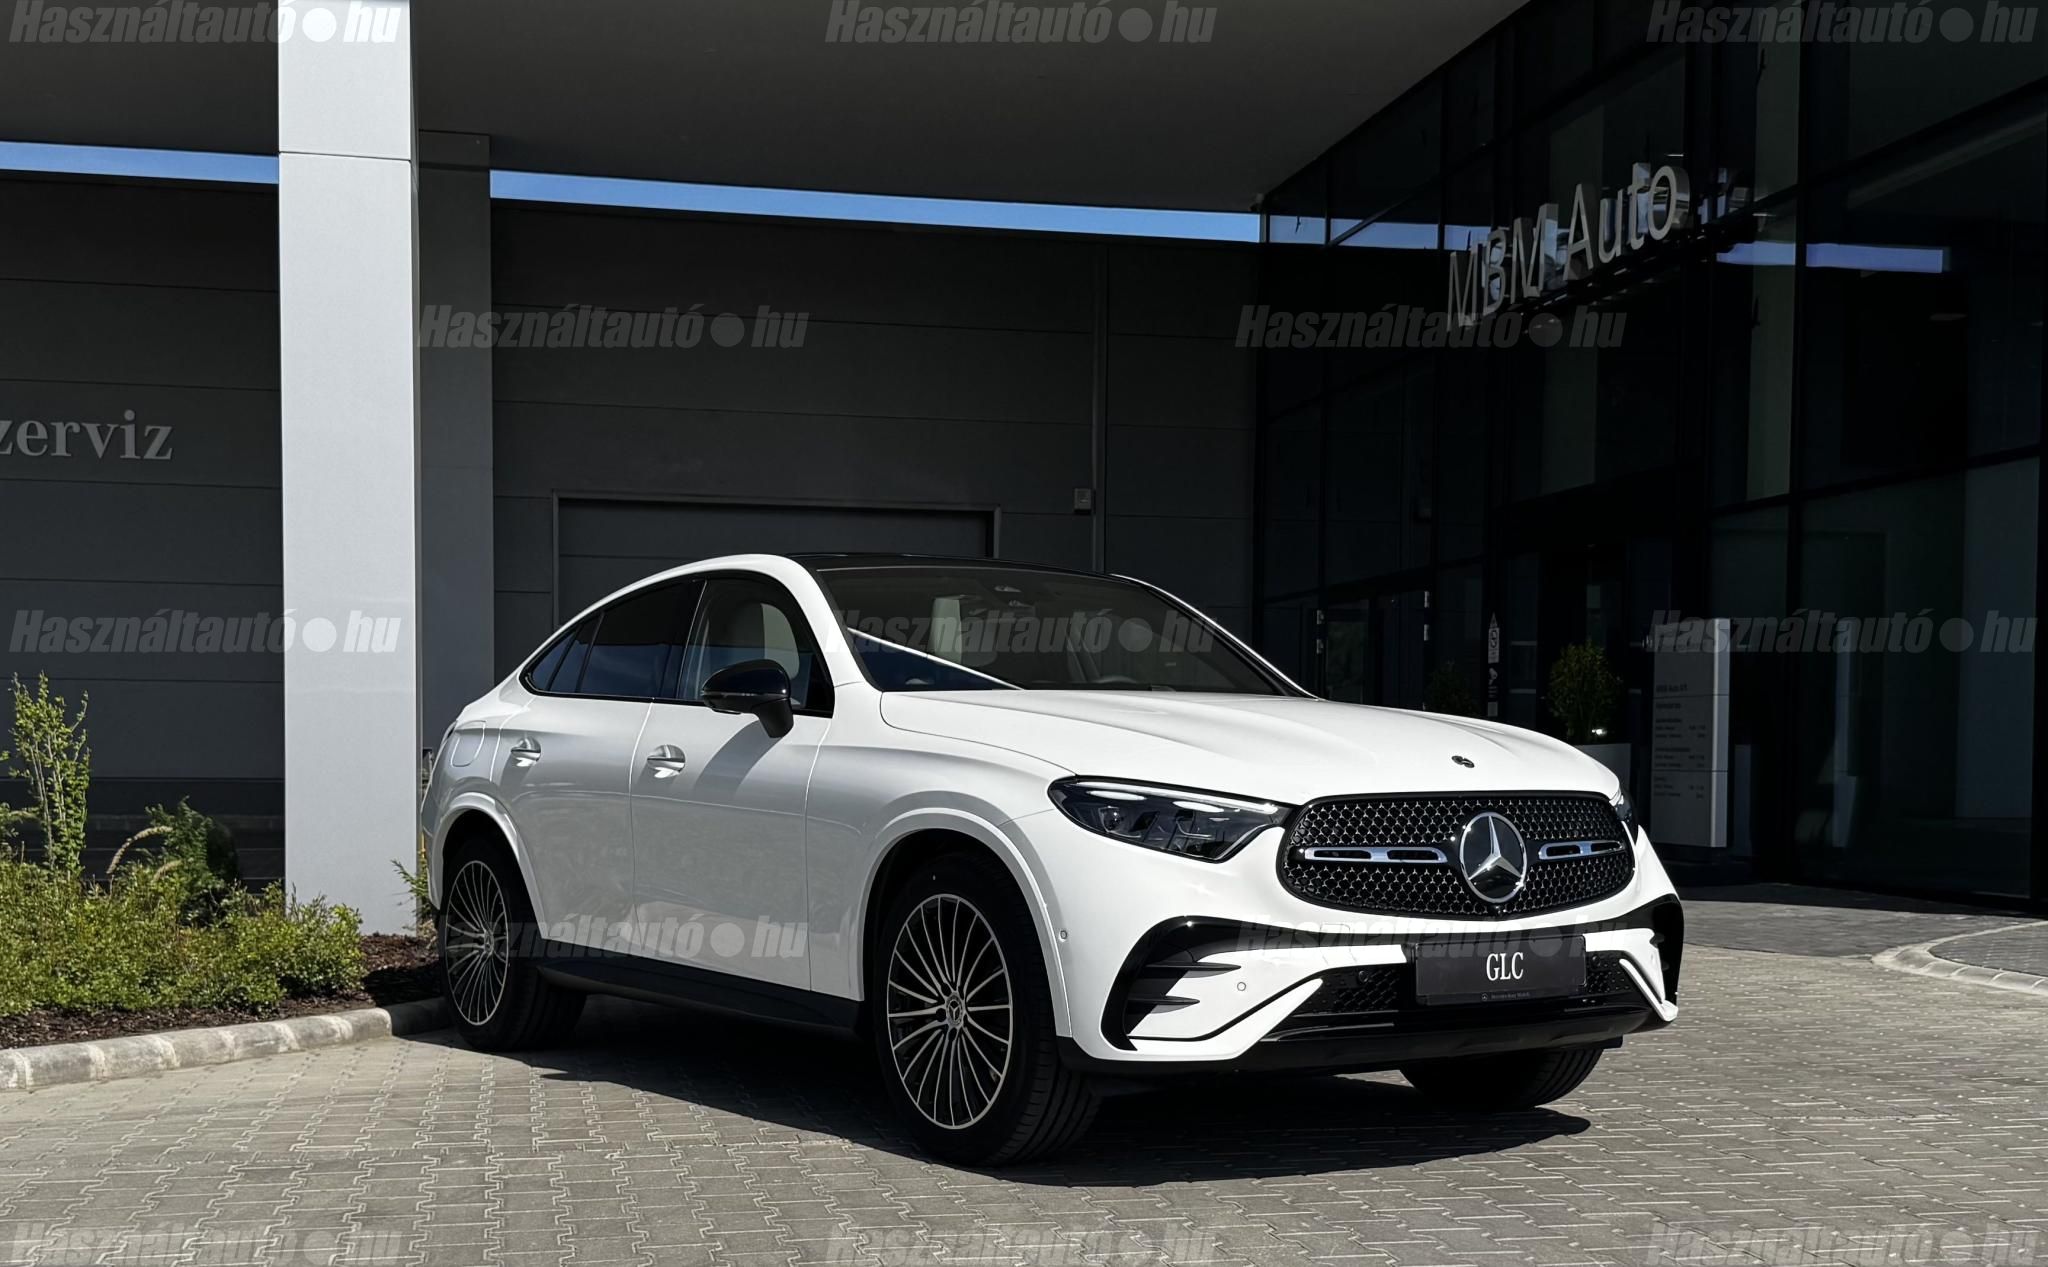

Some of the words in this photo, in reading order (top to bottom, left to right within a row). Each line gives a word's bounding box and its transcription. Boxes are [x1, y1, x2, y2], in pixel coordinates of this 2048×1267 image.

[1446, 203, 1556, 332] MBM
[1563, 162, 1686, 281] Auto
[1486, 952, 1524, 981] GLC
